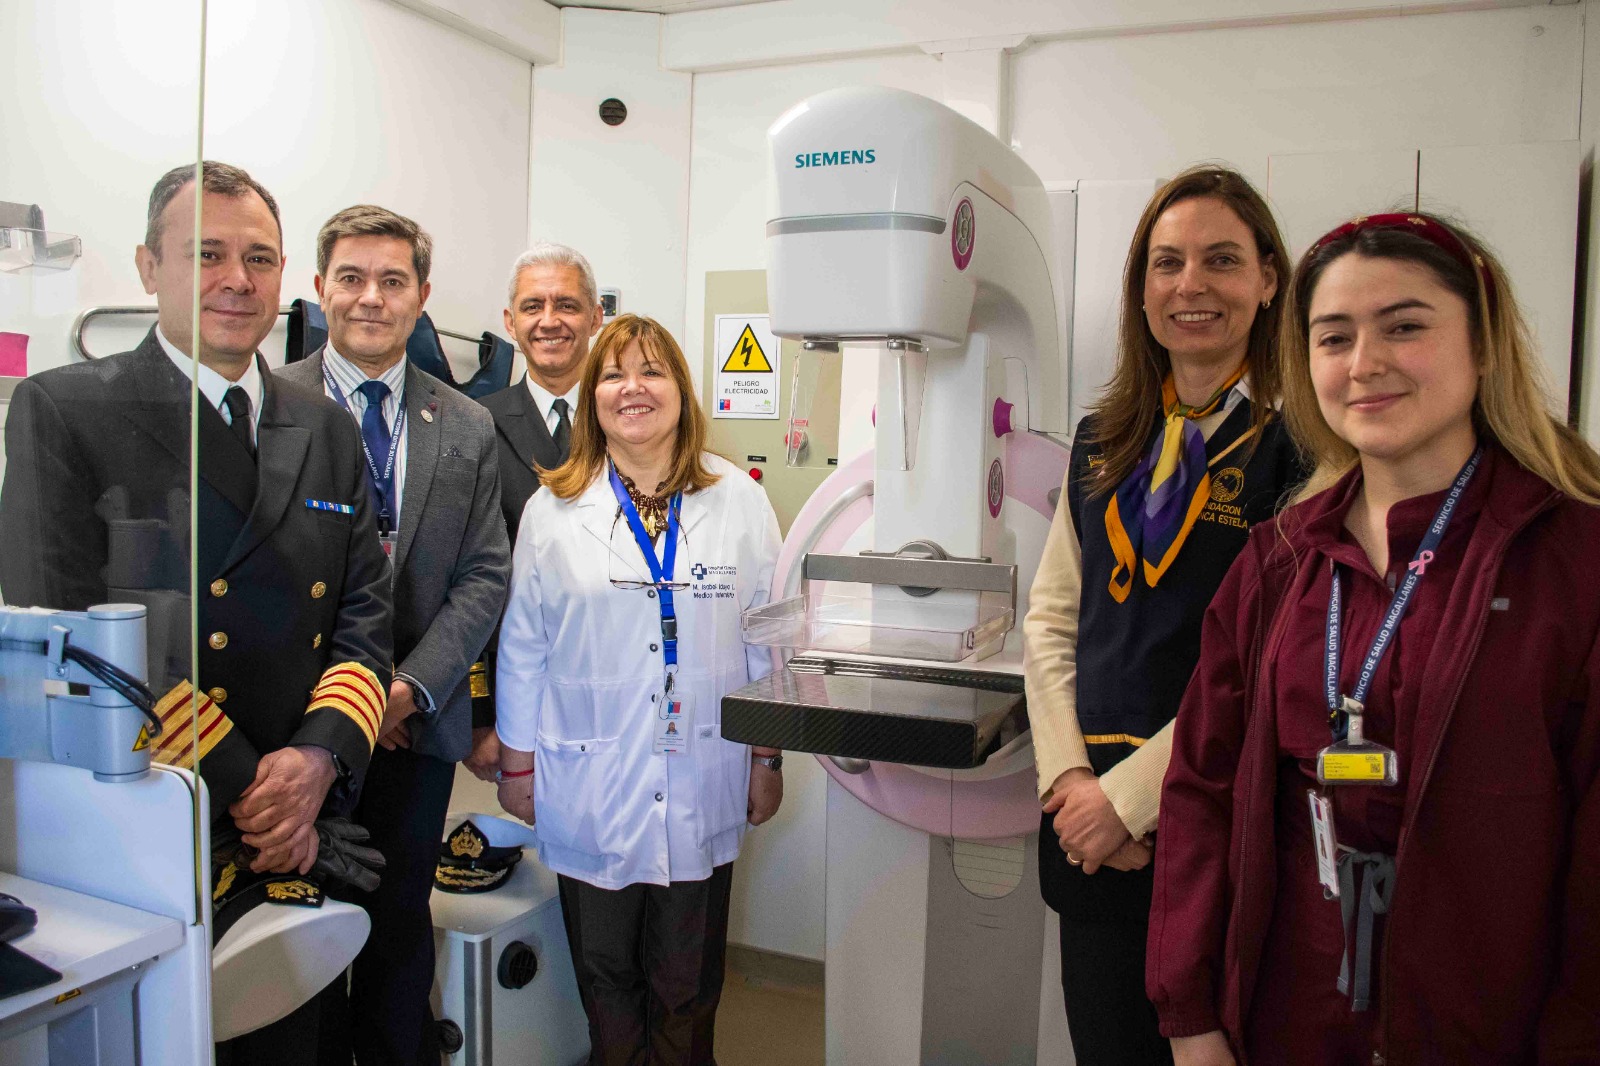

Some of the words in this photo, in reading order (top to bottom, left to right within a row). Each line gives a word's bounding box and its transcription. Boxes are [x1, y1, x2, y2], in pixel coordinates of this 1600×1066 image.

[795, 149, 876, 169] SIEMENS
[388, 449, 395, 457] DE
[390, 434, 398, 450] SALUD
[363, 447, 380, 480] MAGALLANES
[383, 457, 393, 479] SERVICIO
[1205, 502, 1242, 516] NDACION
[1432, 499, 1455, 535] SERVICIO
[1451, 486, 1462, 498] DE
[1457, 464, 1475, 487] SALUD
[1218, 514, 1248, 529] ESTELA
[1331, 578, 1339, 612] SERVICIO
[1330, 613, 1338, 624] DE
[1328, 625, 1338, 651] SALUD
[1354, 671, 1371, 701] RVICIO
[1365, 657, 1376, 671] DE
[1371, 629, 1389, 657] SALUD
[1384, 574, 1417, 629] MAGALLANES
[1327, 652, 1337, 709] MAGALLANES
